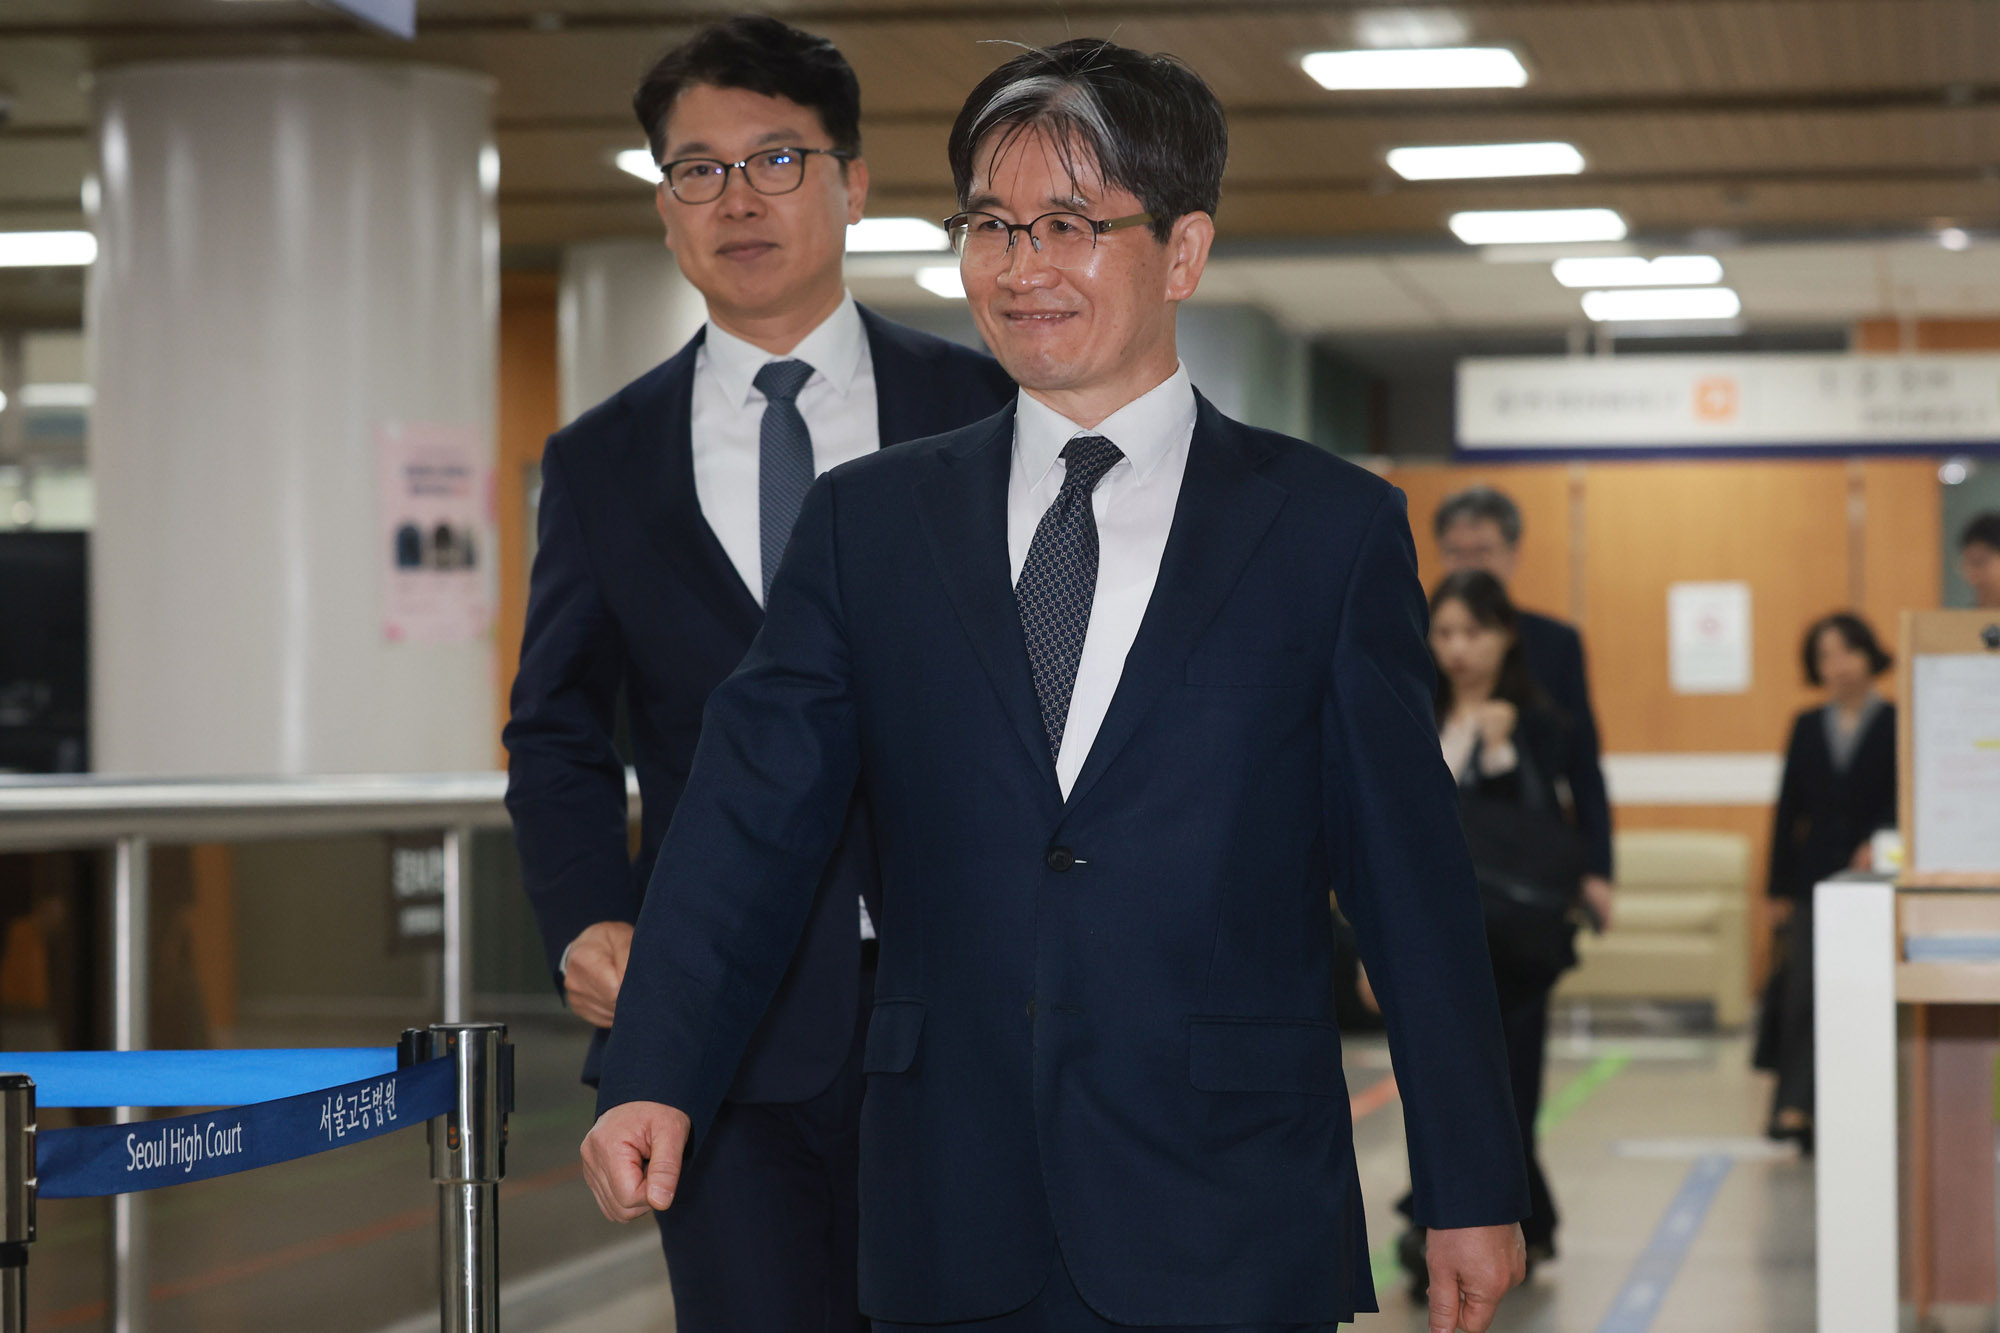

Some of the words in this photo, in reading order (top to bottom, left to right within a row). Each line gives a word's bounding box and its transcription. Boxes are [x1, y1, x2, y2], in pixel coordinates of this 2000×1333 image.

[319, 1079, 397, 1141] 서울고등법원
[126, 1129, 167, 1171] Seoul
[170, 1123, 202, 1172] High
[206, 1121, 242, 1159] Court
